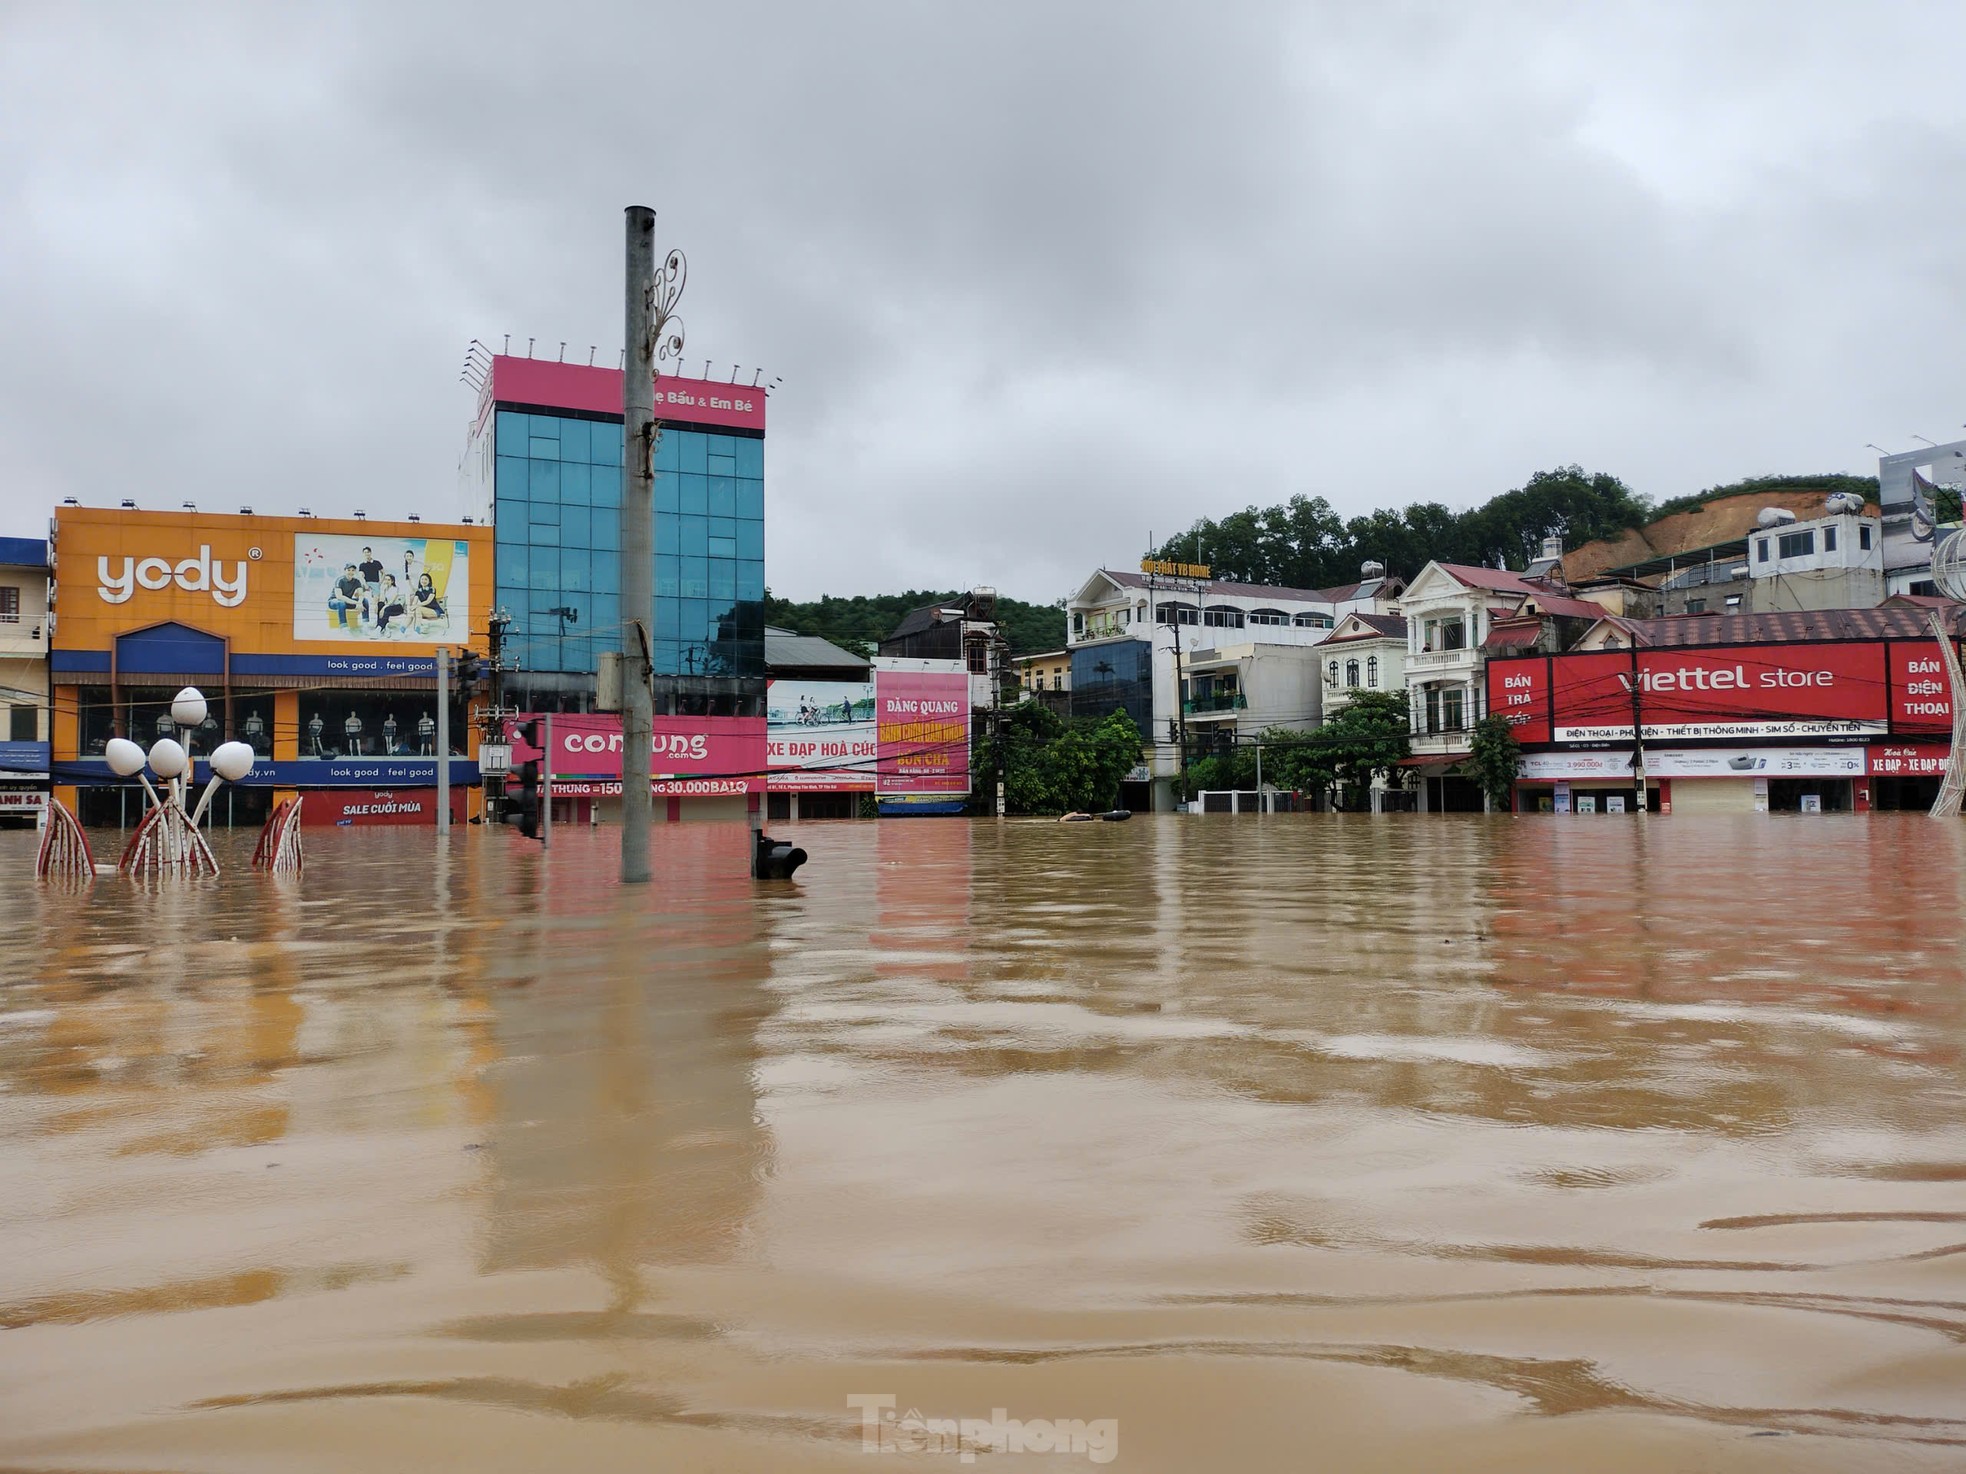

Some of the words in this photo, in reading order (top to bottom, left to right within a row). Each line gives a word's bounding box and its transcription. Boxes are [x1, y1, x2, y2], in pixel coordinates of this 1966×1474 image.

[667, 390, 694, 406] Bầu
[698, 397, 707, 407] &
[710, 397, 731, 411] Em
[734, 399, 753, 413] Bé
[97, 544, 248, 608] yody
[1188, 564, 1212, 579] HOME
[327, 660, 348, 670] look
[351, 661, 377, 672] good
[386, 661, 405, 671] feel
[407, 662, 433, 673] good
[1907, 657, 1941, 673] BÁN
[1504, 673, 1532, 688] BÁN
[1617, 665, 1751, 692] viettel
[1759, 668, 1834, 688] store
[1907, 680, 1943, 697] ĐIỆN
[887, 696, 918, 712] ĐĂNG
[920, 700, 959, 715] QUANG
[1505, 690, 1532, 706] TRẢ
[1904, 703, 1949, 717] THOẠI
[1566, 728, 1586, 739] ĐIỆN
[1588, 727, 1614, 738] THOẠI
[1640, 726, 1659, 738] KIỆN
[1666, 724, 1690, 736] THIẾT
[1693, 725, 1702, 737] BỊ
[1704, 723, 1735, 735] THÔNG
[1737, 725, 1759, 734] MINH
[1765, 725, 1781, 733] SIM
[1783, 721, 1796, 733] SỐ
[767, 742, 785, 756] XE
[789, 742, 817, 759] ĐẠP
[821, 740, 848, 756] HOÀ
[1787, 761, 1793, 770] 3
[1872, 758, 1884, 771] XE
[1885, 758, 1902, 773] ĐẠP
[1908, 758, 1920, 771] XE
[1920, 758, 1937, 773] ĐẠP
[330, 768, 351, 778] look
[354, 768, 379, 781] good
[388, 768, 407, 778] feel
[409, 768, 434, 780] good
[26, 795, 42, 804] SA
[375, 791, 392, 799] yody
[343, 804, 369, 816] SALE
[370, 800, 397, 814] CUỐI
[398, 800, 421, 813] MÙA
